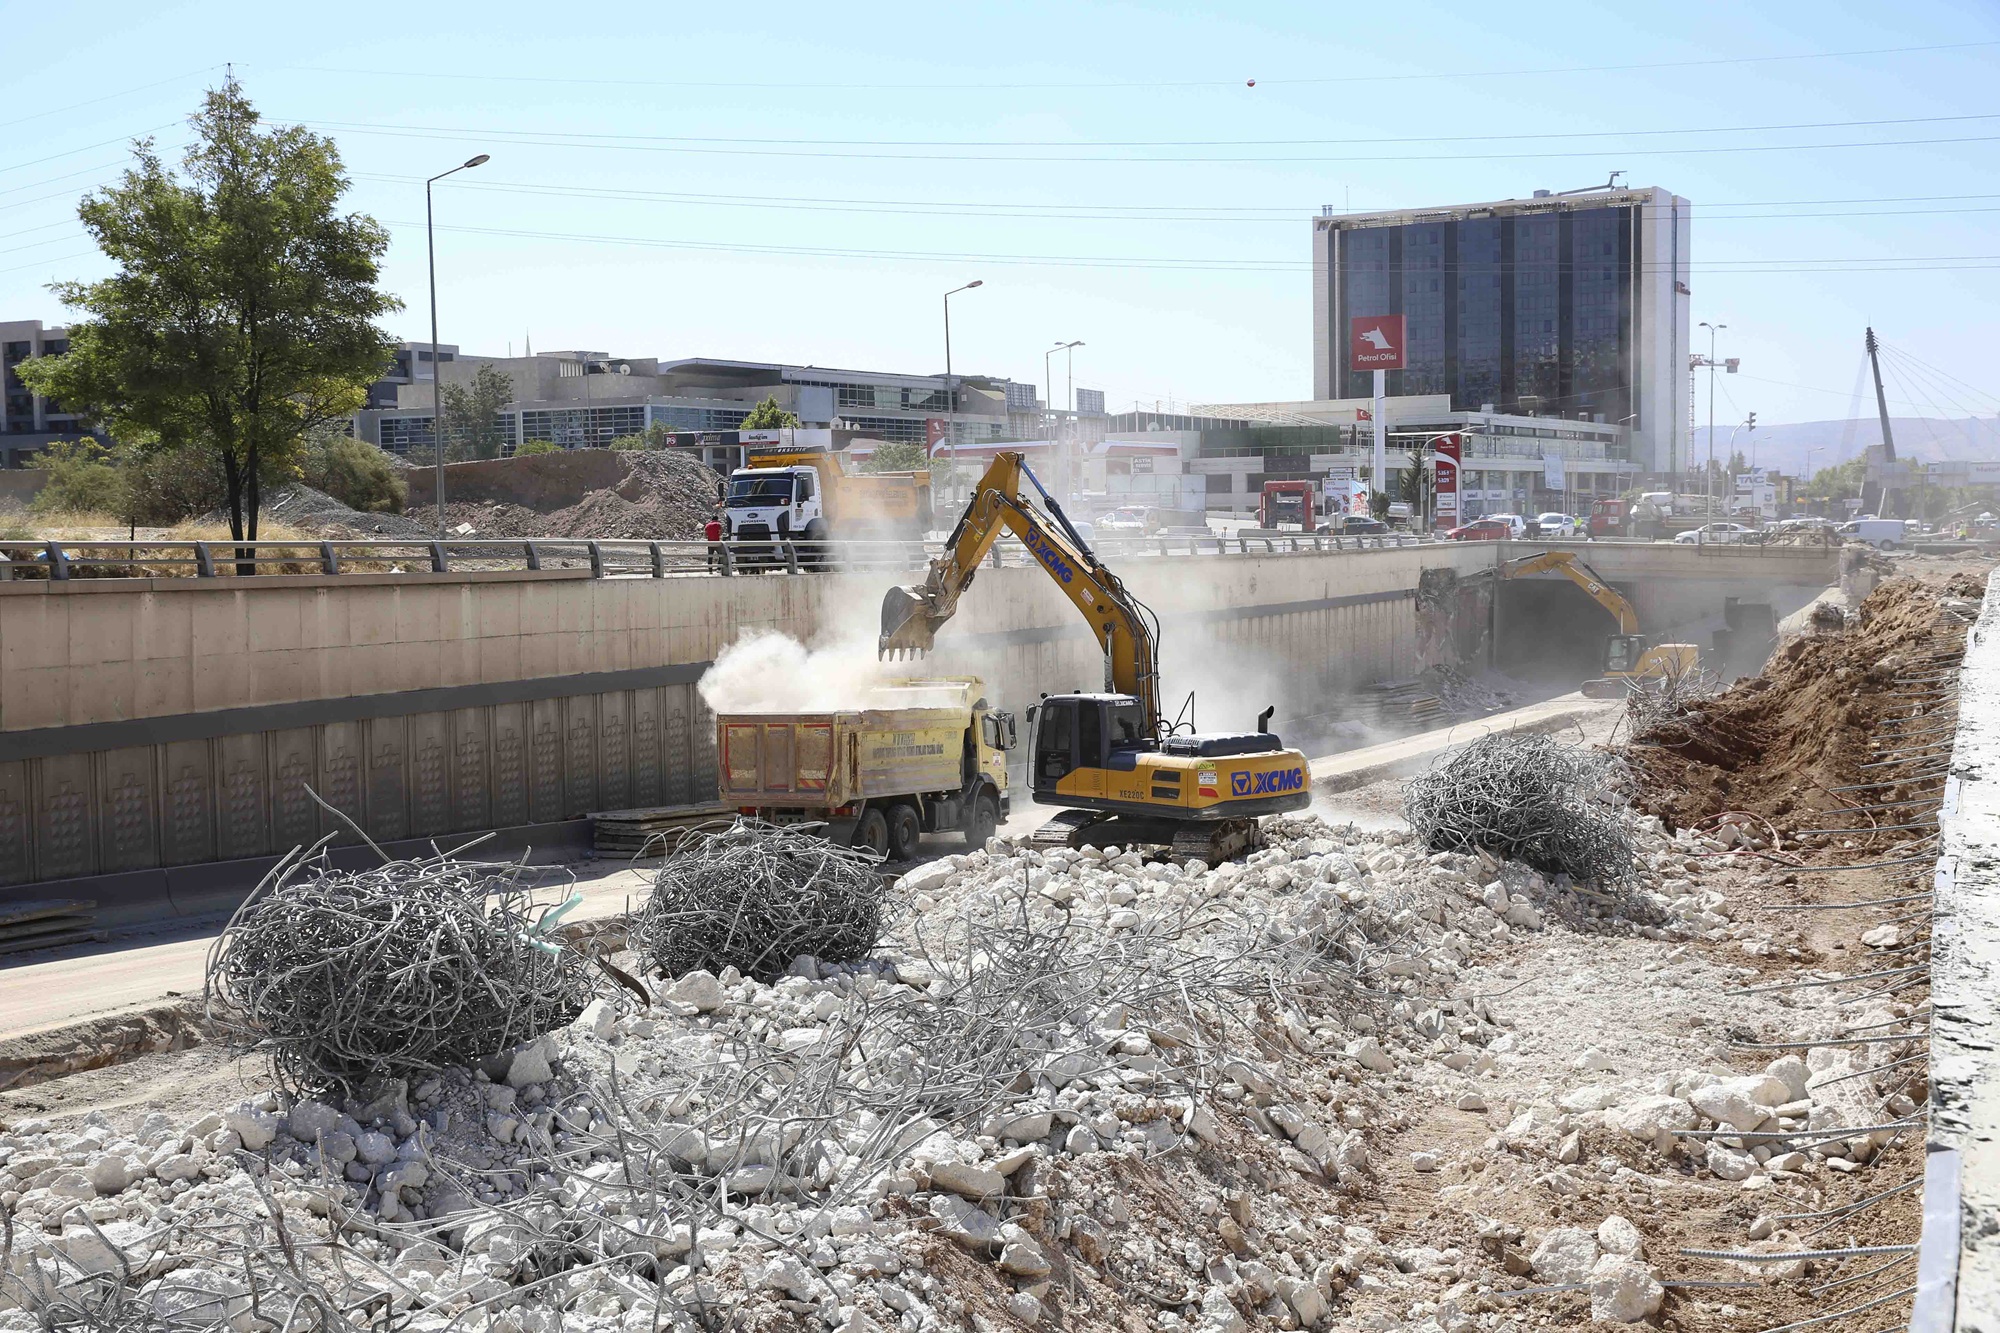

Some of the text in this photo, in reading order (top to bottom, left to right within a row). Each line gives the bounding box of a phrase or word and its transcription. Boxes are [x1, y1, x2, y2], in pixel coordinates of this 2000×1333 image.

[1358, 353, 1397, 362] Petrol Ofisi
[1035, 541, 1073, 583] XCMG
[1588, 583, 1599, 593] CAT
[1252, 767, 1303, 794] XCMG
[1119, 789, 1145, 800] XE220C
